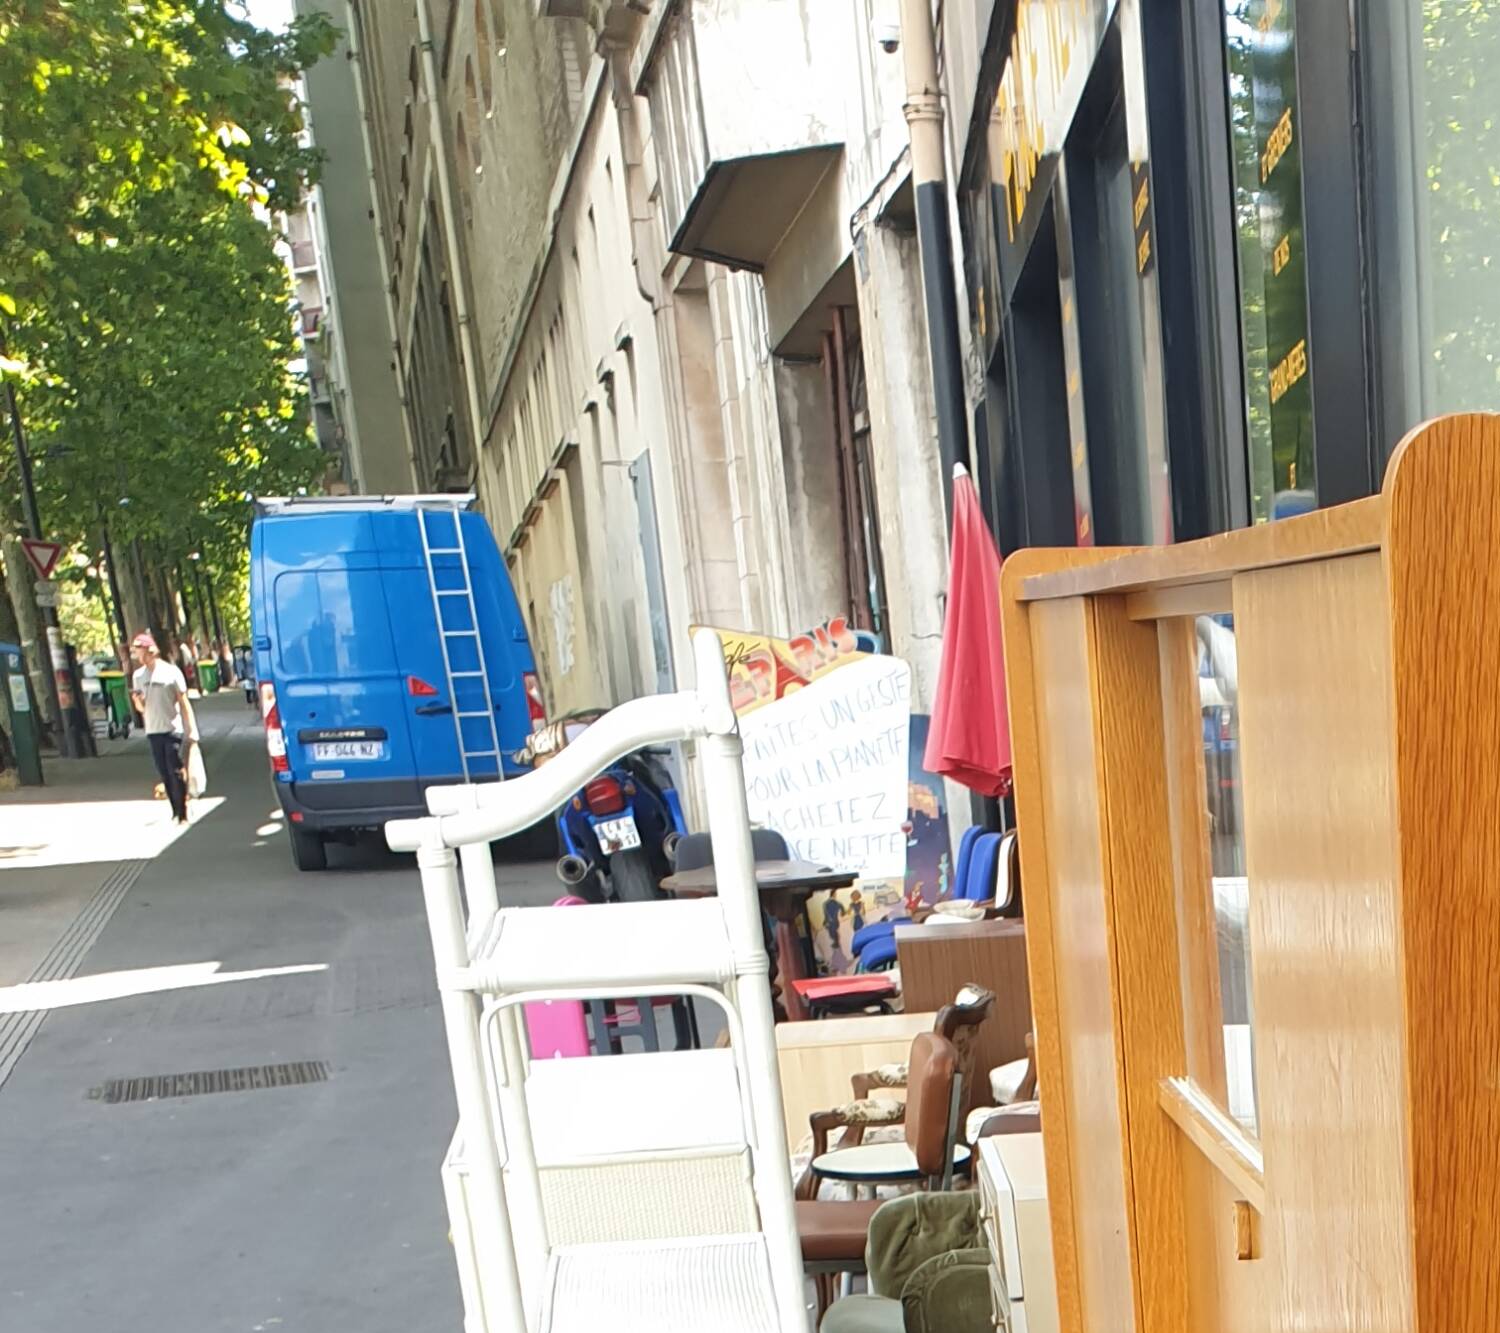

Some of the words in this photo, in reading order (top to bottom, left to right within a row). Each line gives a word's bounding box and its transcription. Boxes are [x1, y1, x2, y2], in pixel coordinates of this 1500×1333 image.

[819, 695, 856, 730] UN
[856, 669, 909, 713] GESTE
[802, 758, 832, 788] LA
[767, 791, 892, 833] ACHETEZ
[832, 831, 901, 861] NETTE
